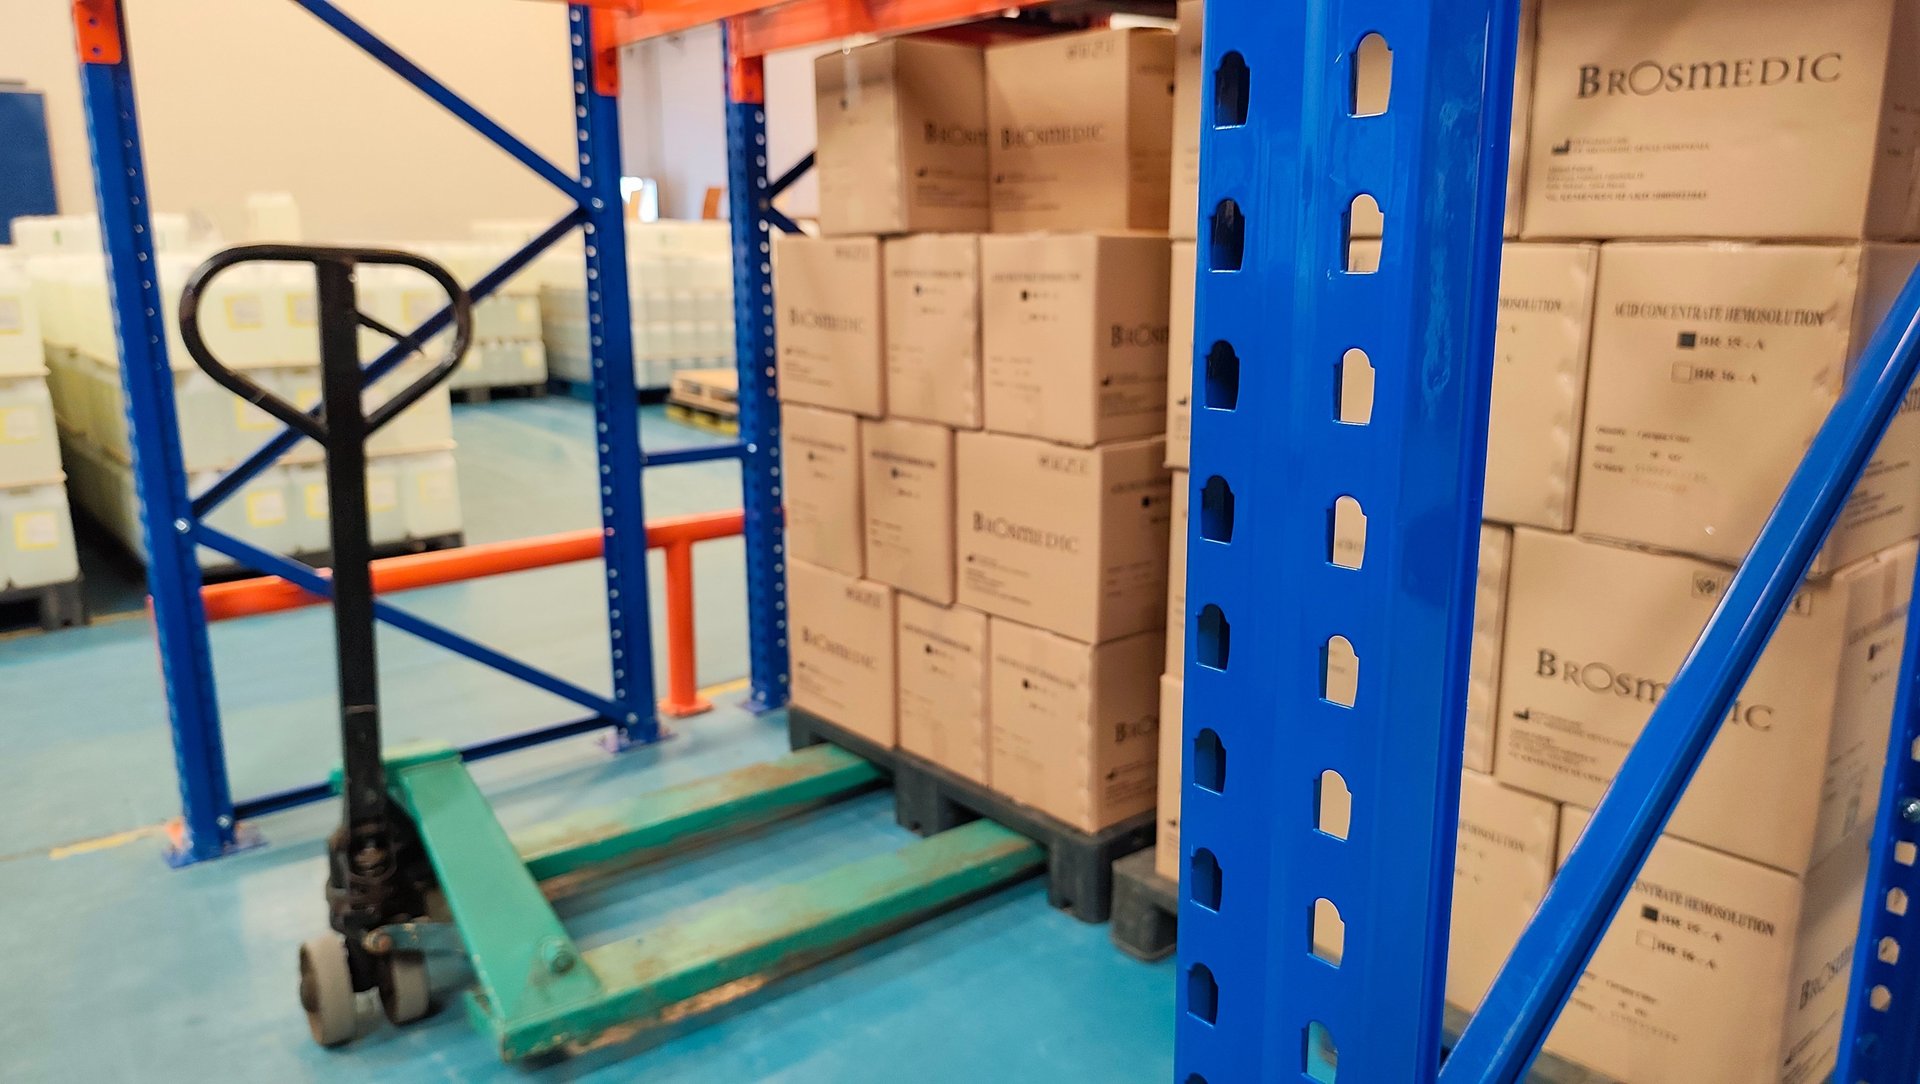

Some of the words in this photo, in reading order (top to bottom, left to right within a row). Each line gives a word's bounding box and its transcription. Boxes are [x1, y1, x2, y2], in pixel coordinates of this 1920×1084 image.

[1614, 301, 1639, 318] ACID
[1724, 305, 1825, 326] HEMOSOLUTION
[1684, 894, 1776, 936] HEMOSOLUTION
